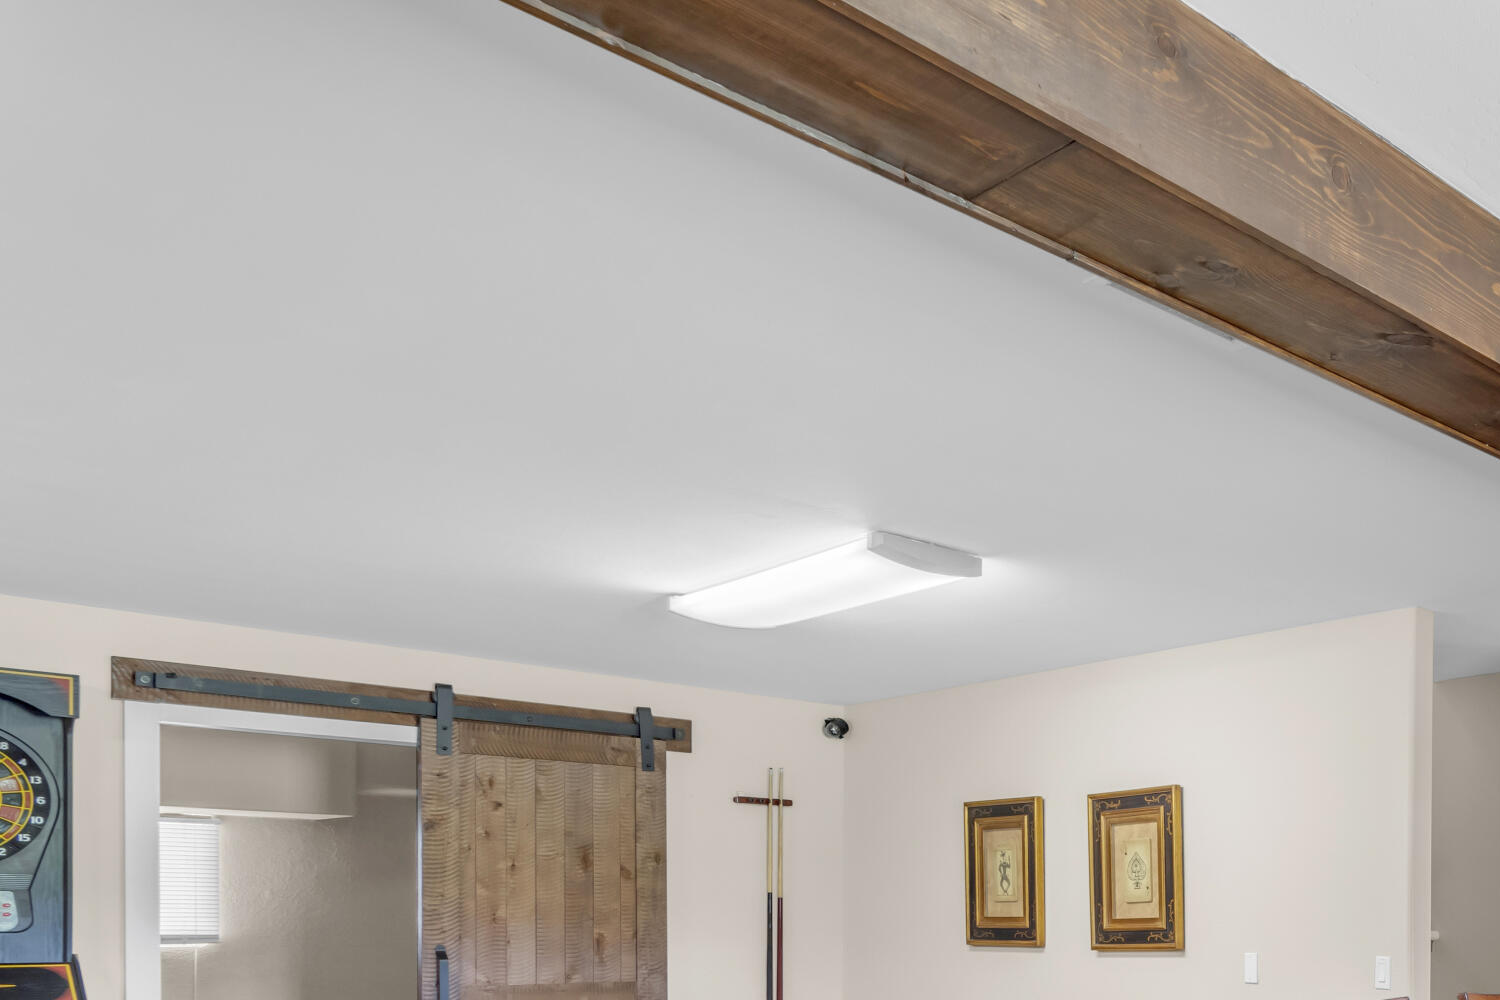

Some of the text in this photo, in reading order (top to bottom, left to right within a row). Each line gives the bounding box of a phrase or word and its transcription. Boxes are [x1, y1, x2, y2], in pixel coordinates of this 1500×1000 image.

[19, 758, 28, 766] 4
[30, 776, 42, 784] 13
[36, 796, 46, 804] 6
[30, 816, 44, 825] 10
[18, 834, 31, 842] 15
